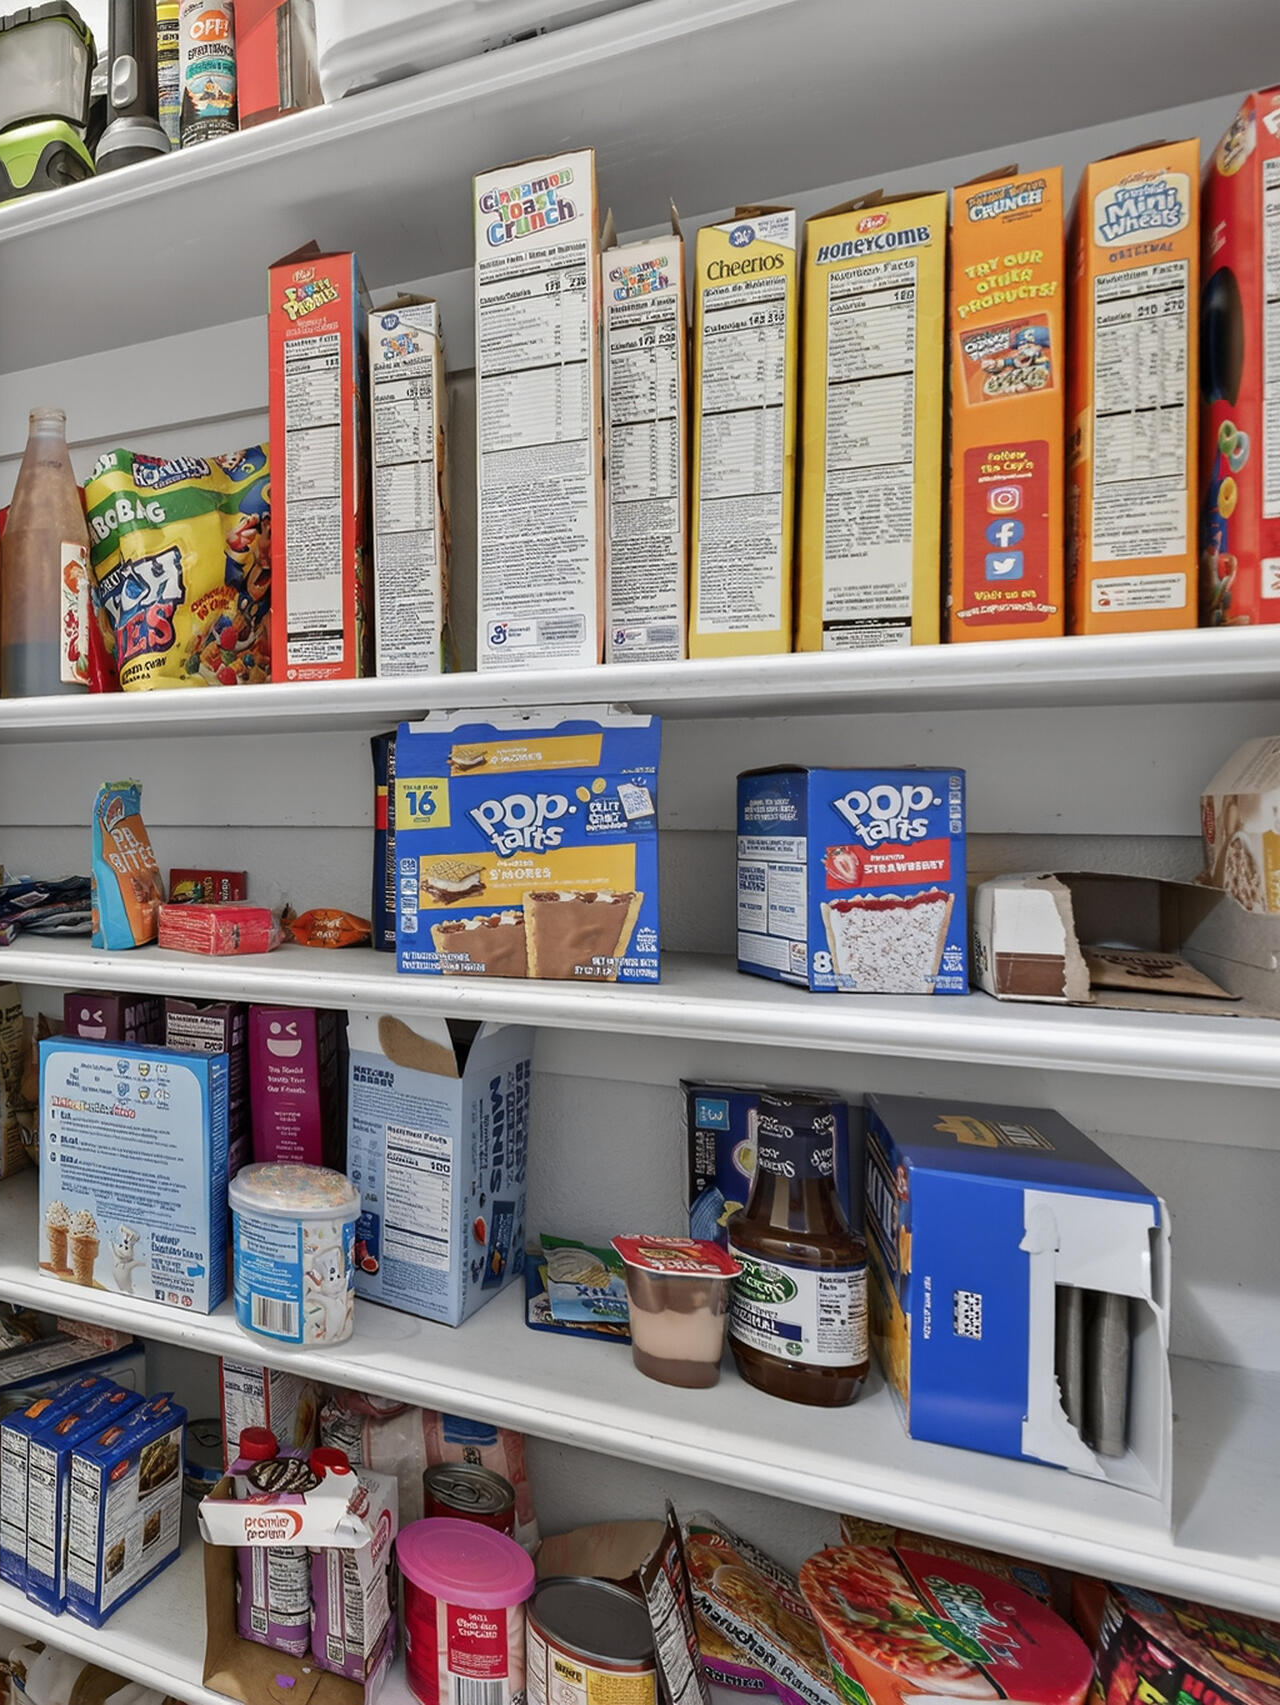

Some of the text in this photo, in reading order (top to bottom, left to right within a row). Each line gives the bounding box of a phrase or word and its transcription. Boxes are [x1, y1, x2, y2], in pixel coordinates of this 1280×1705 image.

[189, 18, 229, 39] OFF!
[479, 167, 574, 213] Cinnamon
[498, 190, 558, 222] Toast
[969, 189, 1044, 222] CRUNCH
[1105, 189, 1179, 222] Mini
[486, 198, 576, 246] Crunch
[1098, 206, 1182, 242] Wheats
[816, 225, 931, 264] HONEYCOMB
[1003, 249, 1044, 265] OUR
[706, 252, 785, 281] Cheerios
[957, 281, 1058, 319] PRODUCTS!
[405, 790, 437, 816] 16
[863, 858, 946, 875] STRAWBERRY
[812, 950, 832, 973] 8
[488, 1075, 504, 1194] MINIS
[693, 1594, 778, 1669] Maruchan
